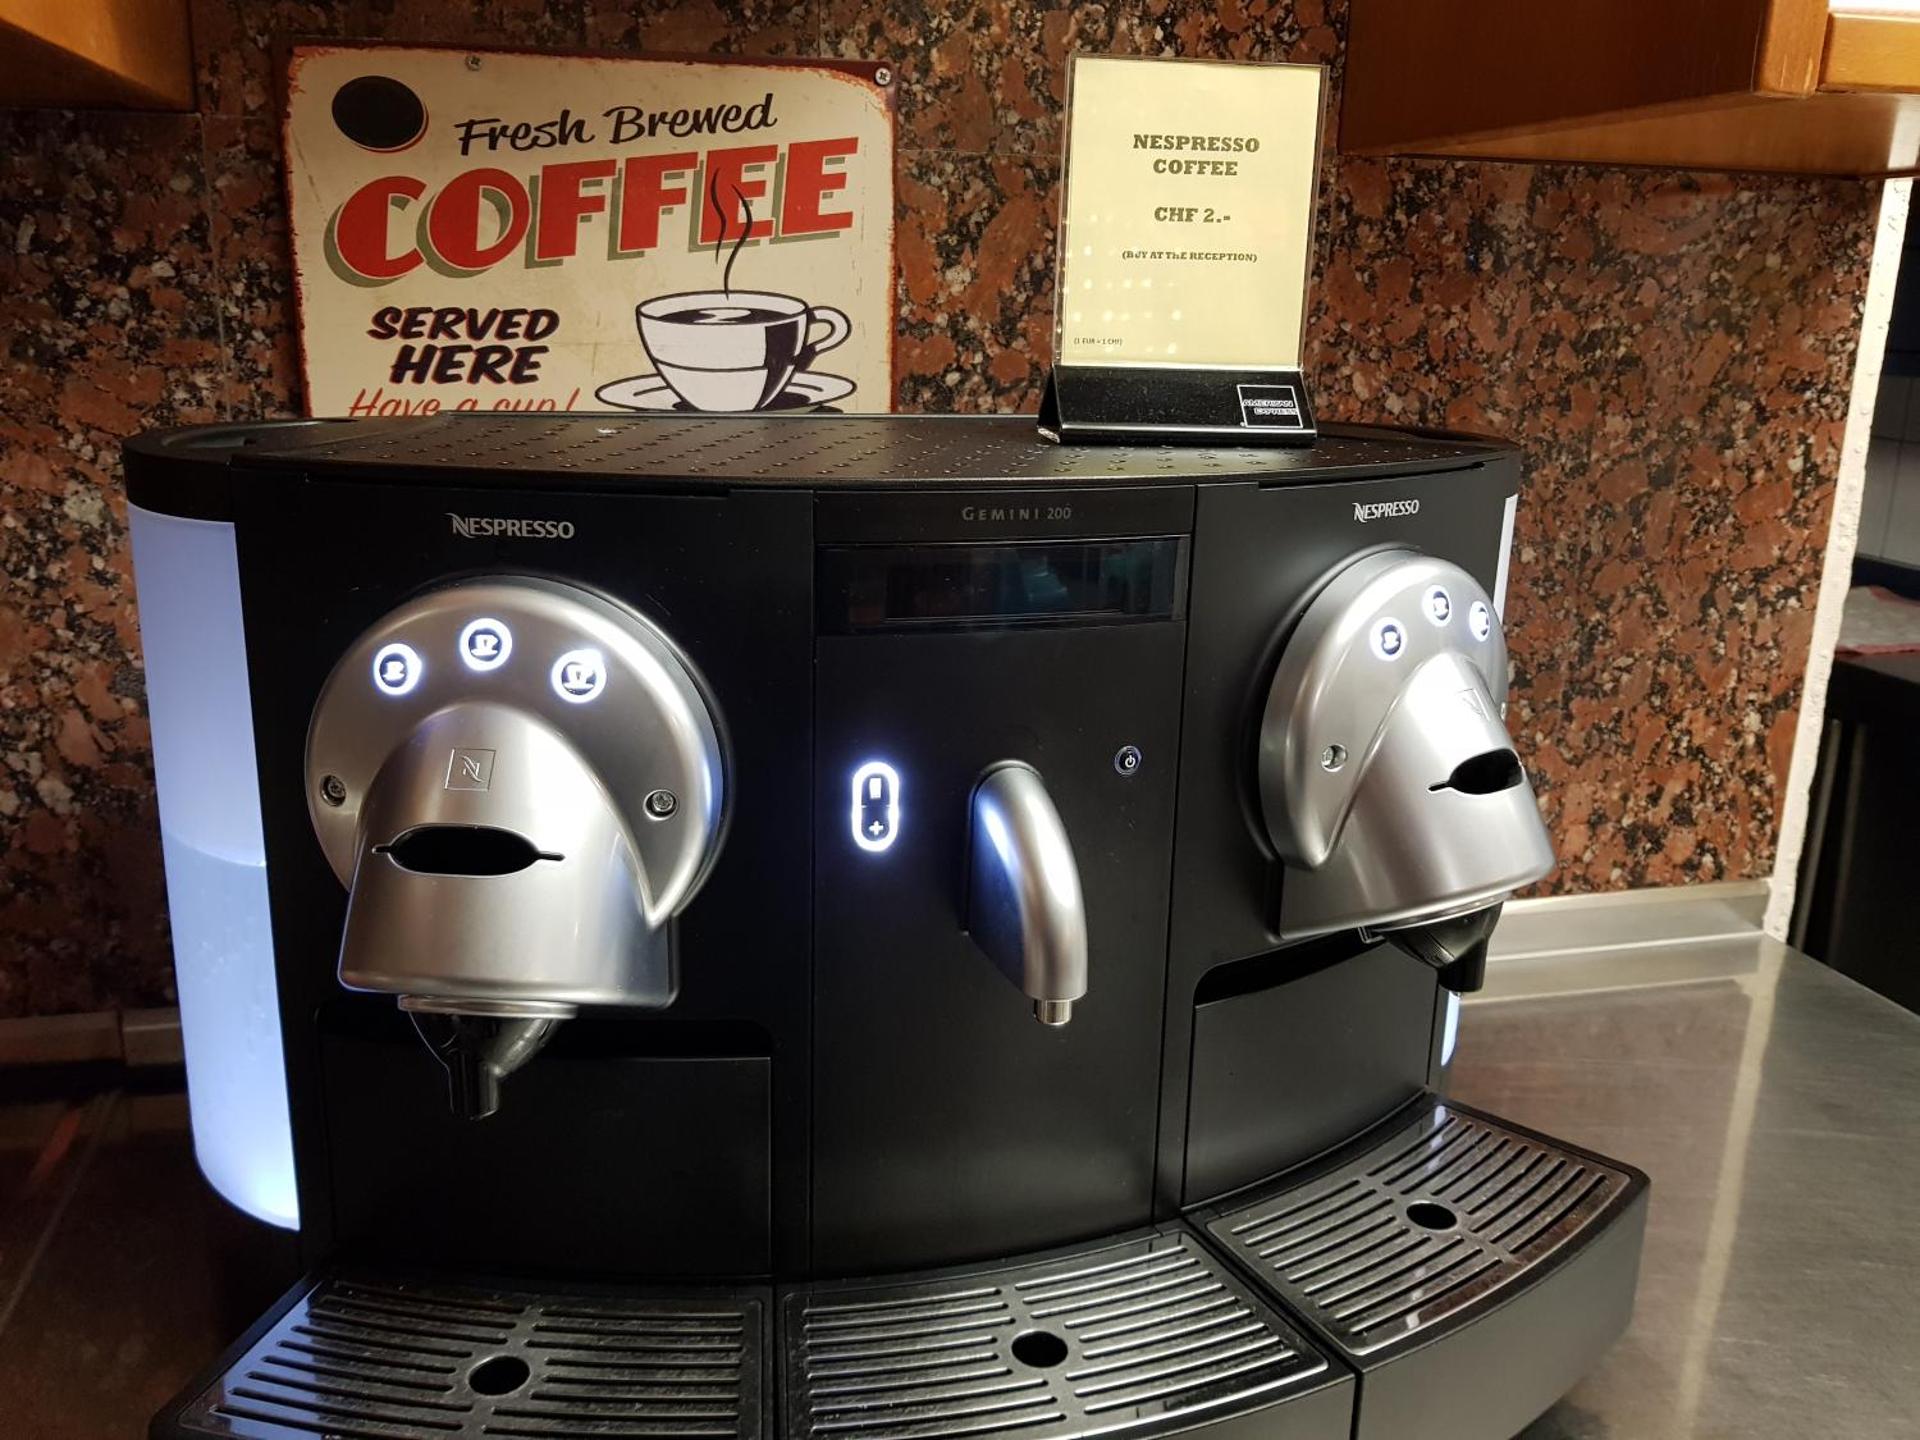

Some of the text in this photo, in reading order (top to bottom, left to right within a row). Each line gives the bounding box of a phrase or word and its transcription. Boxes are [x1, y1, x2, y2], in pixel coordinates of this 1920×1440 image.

[455, 93, 778, 156] Fresh Brewed
[1133, 134, 1260, 153] NESPRESSO
[1152, 158, 1238, 176] COFFEE
[326, 137, 858, 285] COFFEE
[1154, 206, 1231, 223] CHF 2.-
[1150, 250, 1164, 261] AT
[1189, 251, 1258, 263] RECEPTION)
[367, 306, 560, 342] SERVED
[389, 344, 548, 385] HERE
[349, 387, 441, 416] Have
[961, 506, 1072, 521] GEMINI 200
[1353, 499, 1420, 523] NESPRESSO
[444, 512, 575, 539] NESPRESSO
